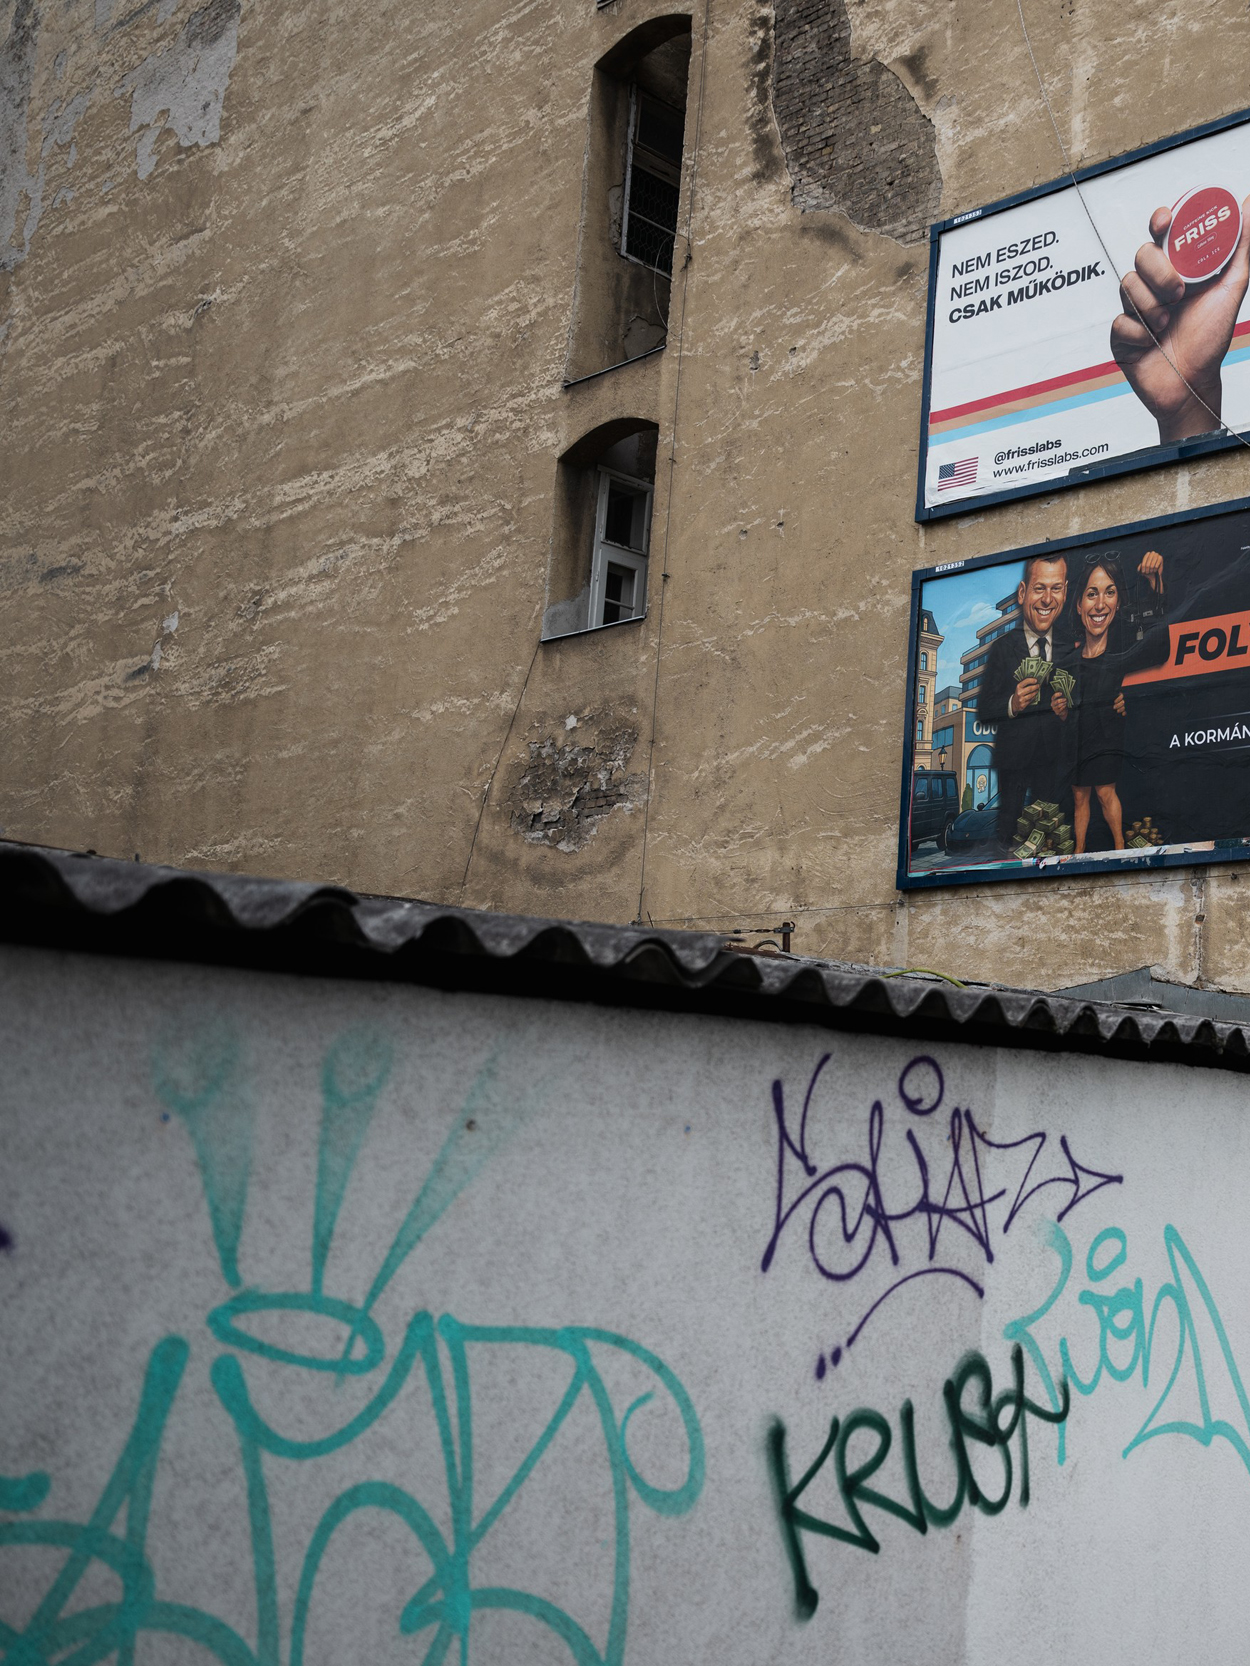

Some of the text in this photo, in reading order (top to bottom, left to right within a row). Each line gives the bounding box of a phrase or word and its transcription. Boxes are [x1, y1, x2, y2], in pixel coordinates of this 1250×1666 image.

[1174, 205, 1231, 252] FRISS
[951, 230, 1060, 279] NEM ESZED.
[948, 261, 1106, 324] CSAK MŰKÖDIK.
[950, 256, 1054, 301] NEM ISZOD.
[992, 443, 1109, 478] www.frisslabs.com
[994, 438, 1062, 465] @frisslabs
[1169, 734, 1181, 748] A
